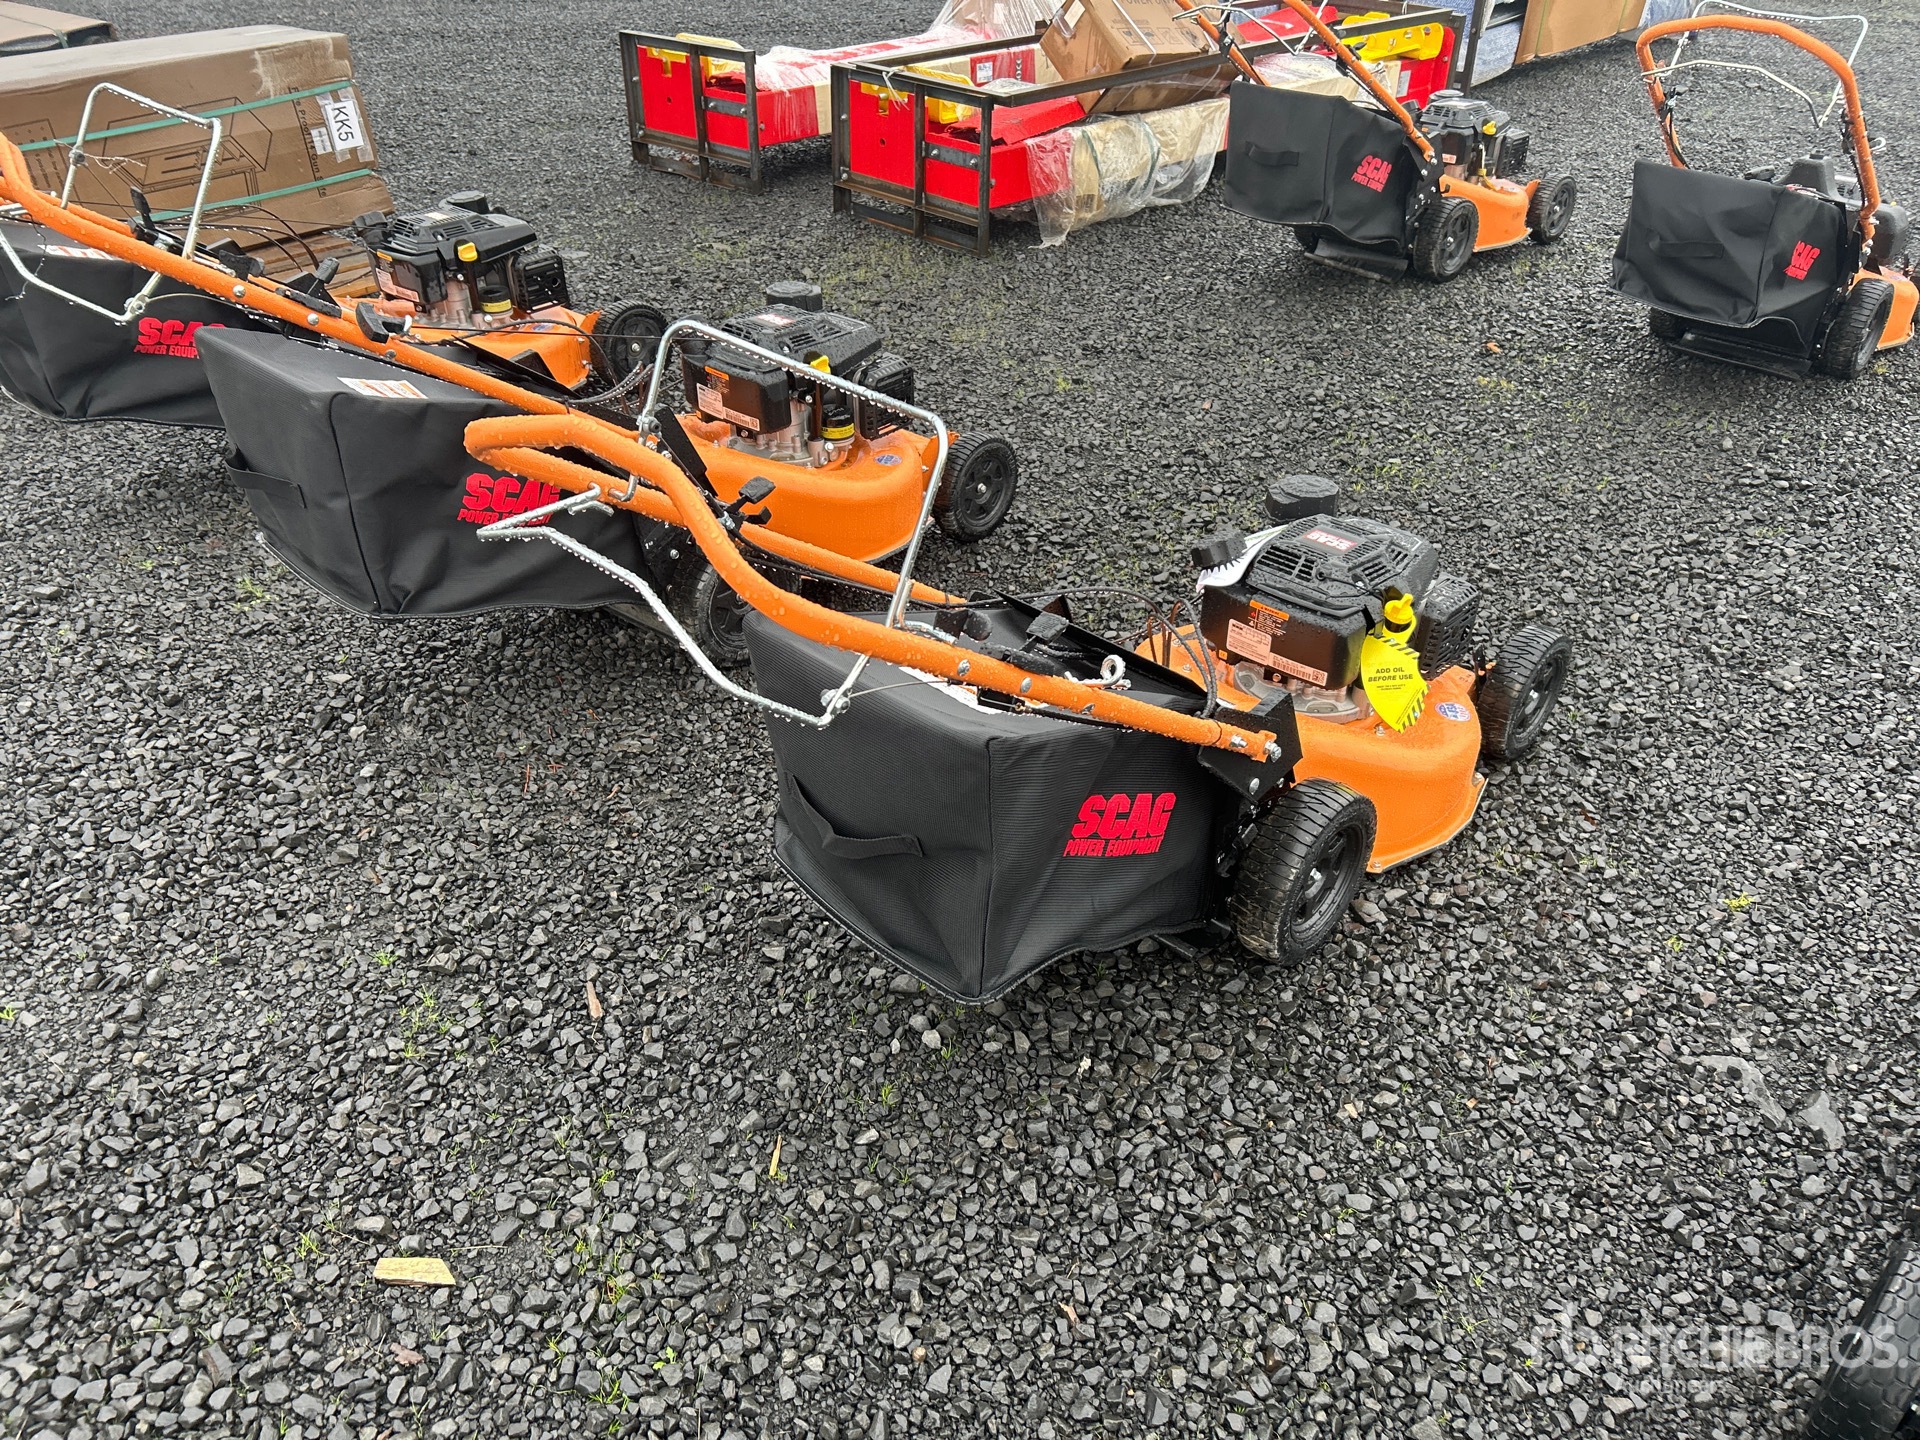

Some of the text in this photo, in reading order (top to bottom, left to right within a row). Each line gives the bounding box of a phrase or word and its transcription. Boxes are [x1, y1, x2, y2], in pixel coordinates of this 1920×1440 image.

[331, 106, 355, 141] KK5
[310, 154, 320, 173] Gun
[316, 175, 327, 198] Sfe
[138, 317, 224, 346] SCA
[133, 344, 167, 355] POWER
[457, 508, 500, 525] POWER
[1071, 792, 1176, 839] SCAG
[1063, 839, 1105, 857] POWER
